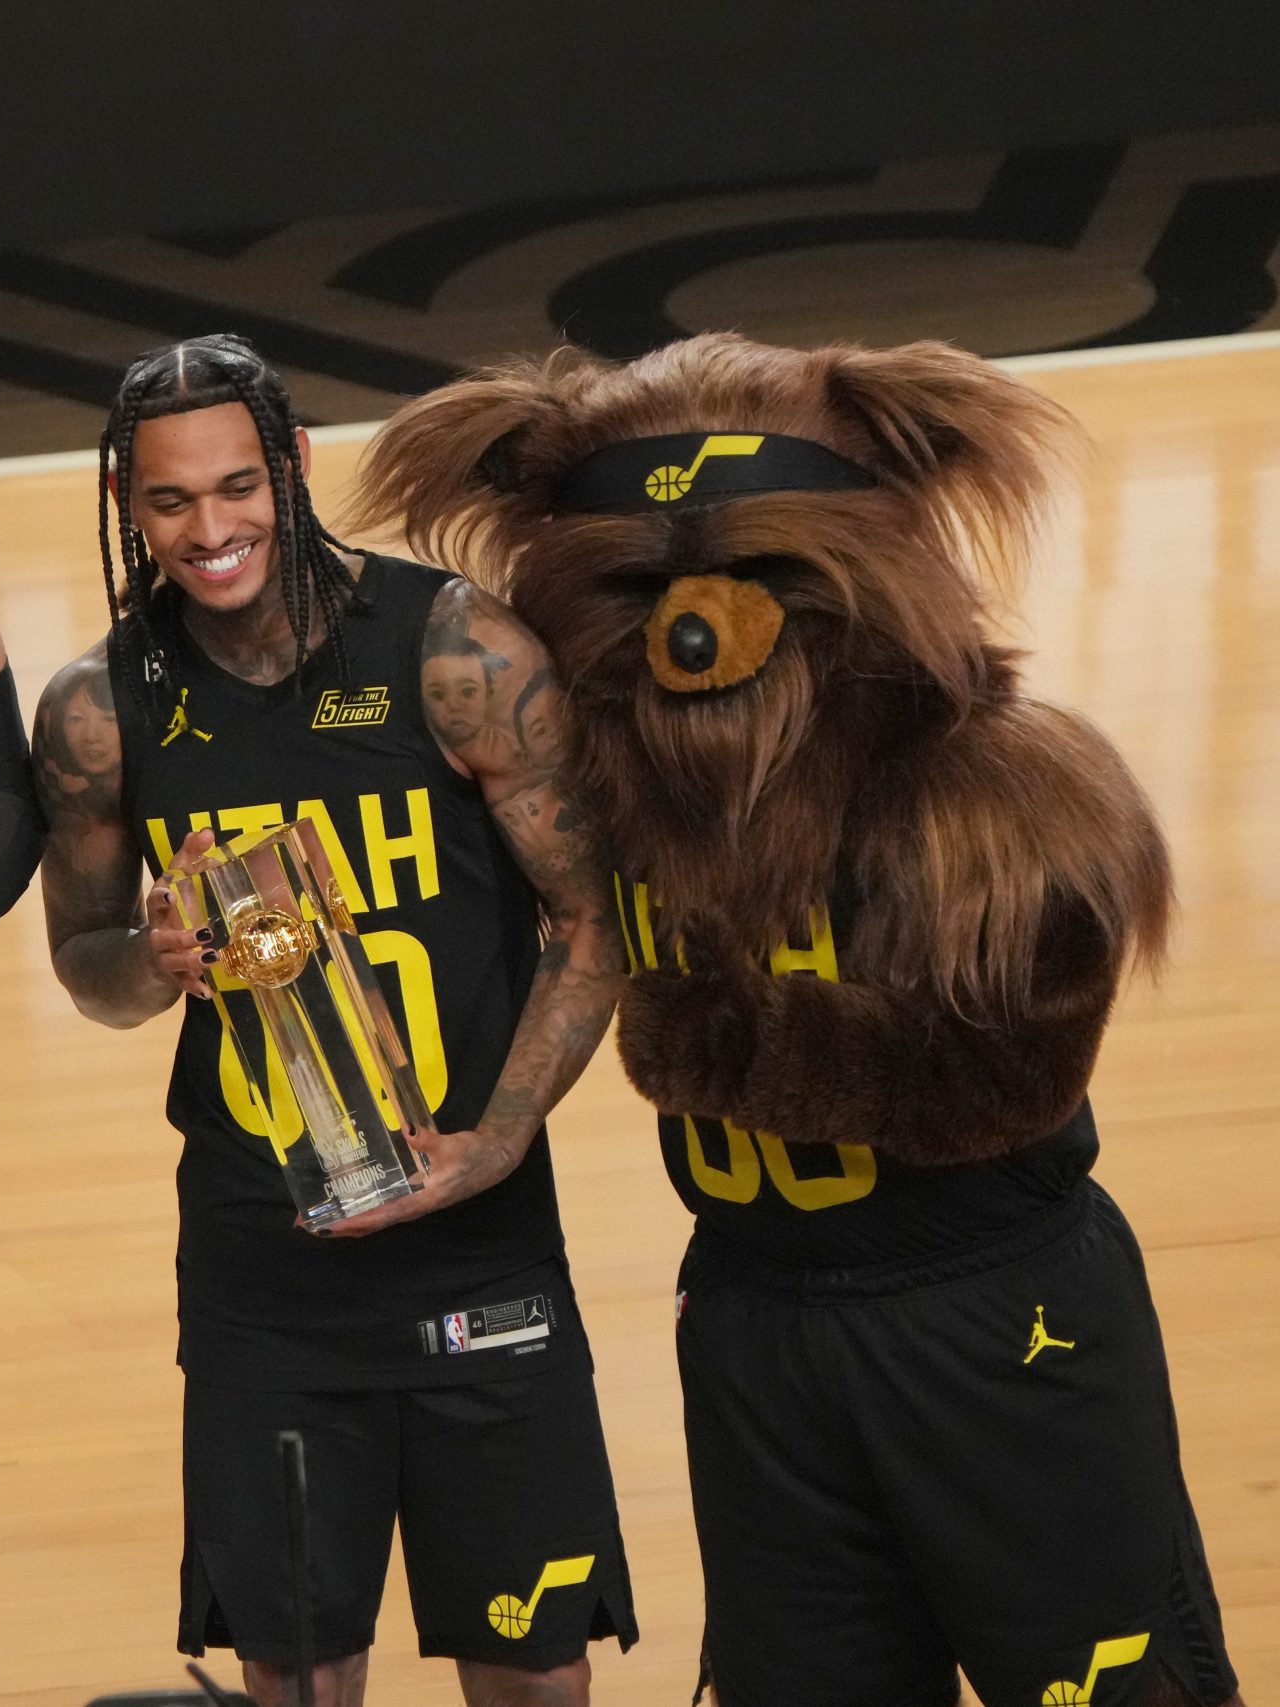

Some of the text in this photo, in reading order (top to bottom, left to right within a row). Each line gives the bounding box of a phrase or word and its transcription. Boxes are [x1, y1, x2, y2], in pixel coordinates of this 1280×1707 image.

[365, 692, 381, 701] THE
[321, 695, 341, 723] 5
[341, 706, 384, 722] FIGHT
[323, 1163, 387, 1199] CHAMPIONS
